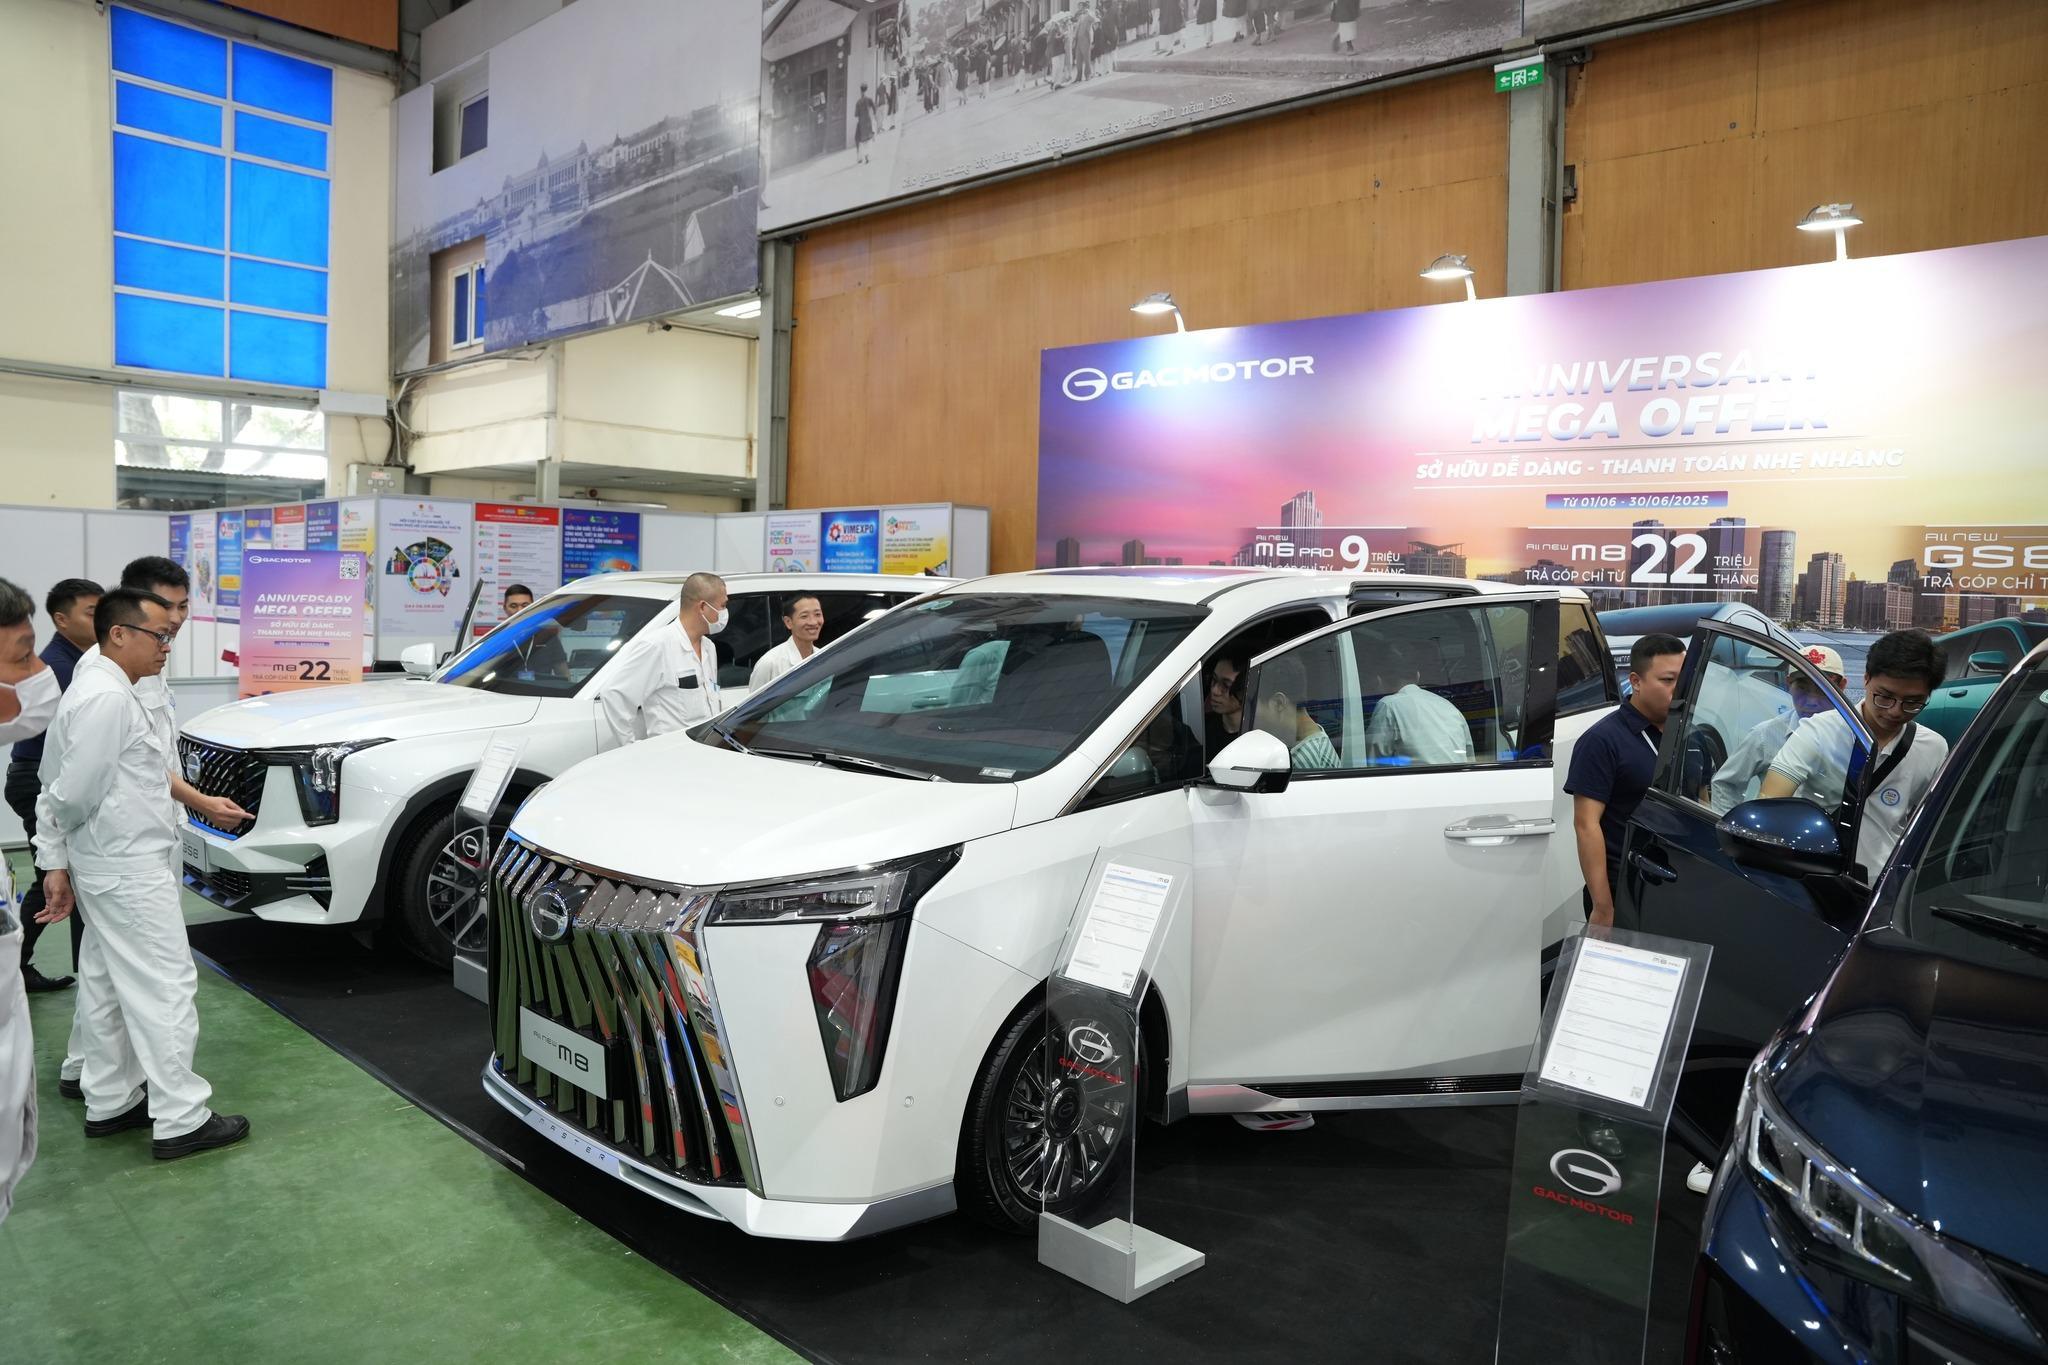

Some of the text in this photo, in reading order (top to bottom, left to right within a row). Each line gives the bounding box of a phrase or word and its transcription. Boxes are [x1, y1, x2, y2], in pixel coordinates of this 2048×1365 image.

[1111, 355, 1315, 391] GAC MOTOR
[1480, 349, 1820, 401] NNIVERSA
[1471, 391, 1829, 443] MEGA OFFER
[1416, 456, 1443, 479] SỞ
[1446, 458, 1489, 479] HỮU
[1491, 454, 1520, 477] DỄ
[1523, 457, 1583, 477] DÀNG
[1601, 456, 1677, 475] THANH
[1683, 451, 1749, 472] TOÁN
[1753, 452, 1803, 473] NHẸ
[1807, 446, 1905, 470] NHÀNG
[1581, 496, 1618, 508] 01/06
[1629, 494, 1709, 508] 30/06/2025
[843, 524, 874, 534] VIMEXPO
[1340, 534, 1370, 574] 9
[1371, 550, 1400, 564] TRIỆU
[1630, 533, 1708, 584] 22
[1714, 554, 1752, 568] TRIỆU
[1370, 566, 1406, 575] THÁNG
[1524, 567, 1626, 583] TRẢ GÓP CHỈ TỪ
[1714, 571, 1760, 584] THÁNG
[1922, 572, 1954, 588] TRẢ
[1958, 574, 1998, 589] GÓP
[2002, 573, 2034, 590] CHỈ
[256, 593, 353, 604] ANNIVERSARY
[253, 604, 353, 616] MEGA OFFER
[299, 660, 331, 680] 22
[1532, 1186, 1633, 1225] GAC MOTOR
